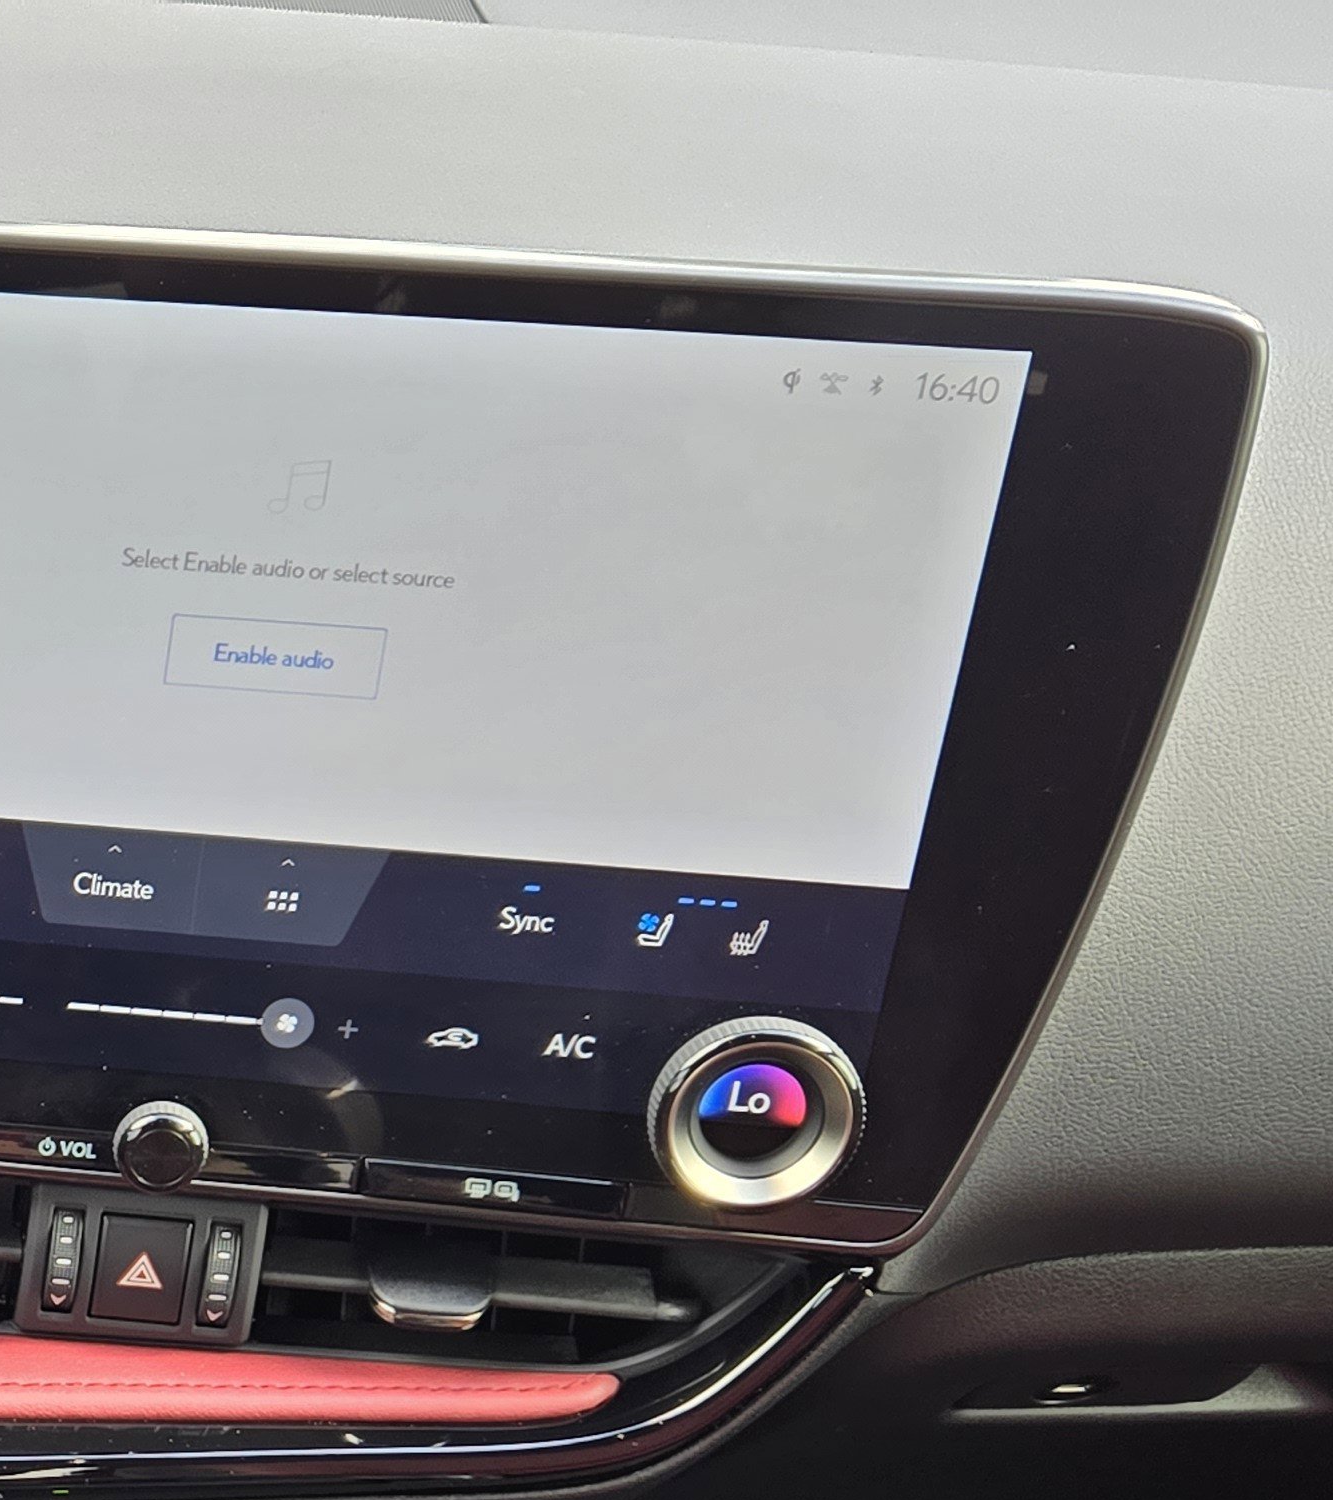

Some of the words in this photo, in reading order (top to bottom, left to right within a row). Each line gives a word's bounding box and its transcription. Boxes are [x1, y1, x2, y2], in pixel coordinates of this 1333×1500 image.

[915, 371, 1001, 405] 16:40
[121, 547, 179, 571] Select
[183, 551, 247, 575] Enable
[252, 558, 305, 580] audio
[309, 565, 330, 582] or
[333, 563, 389, 585] select
[392, 572, 455, 589] source
[213, 642, 277, 666] Enable
[282, 649, 334, 670] audio
[73, 871, 154, 900] Climate
[497, 905, 555, 935] Sync
[541, 1033, 597, 1059] A/C
[728, 1080, 771, 1114] Lo
[60, 1140, 97, 1160] VOL
